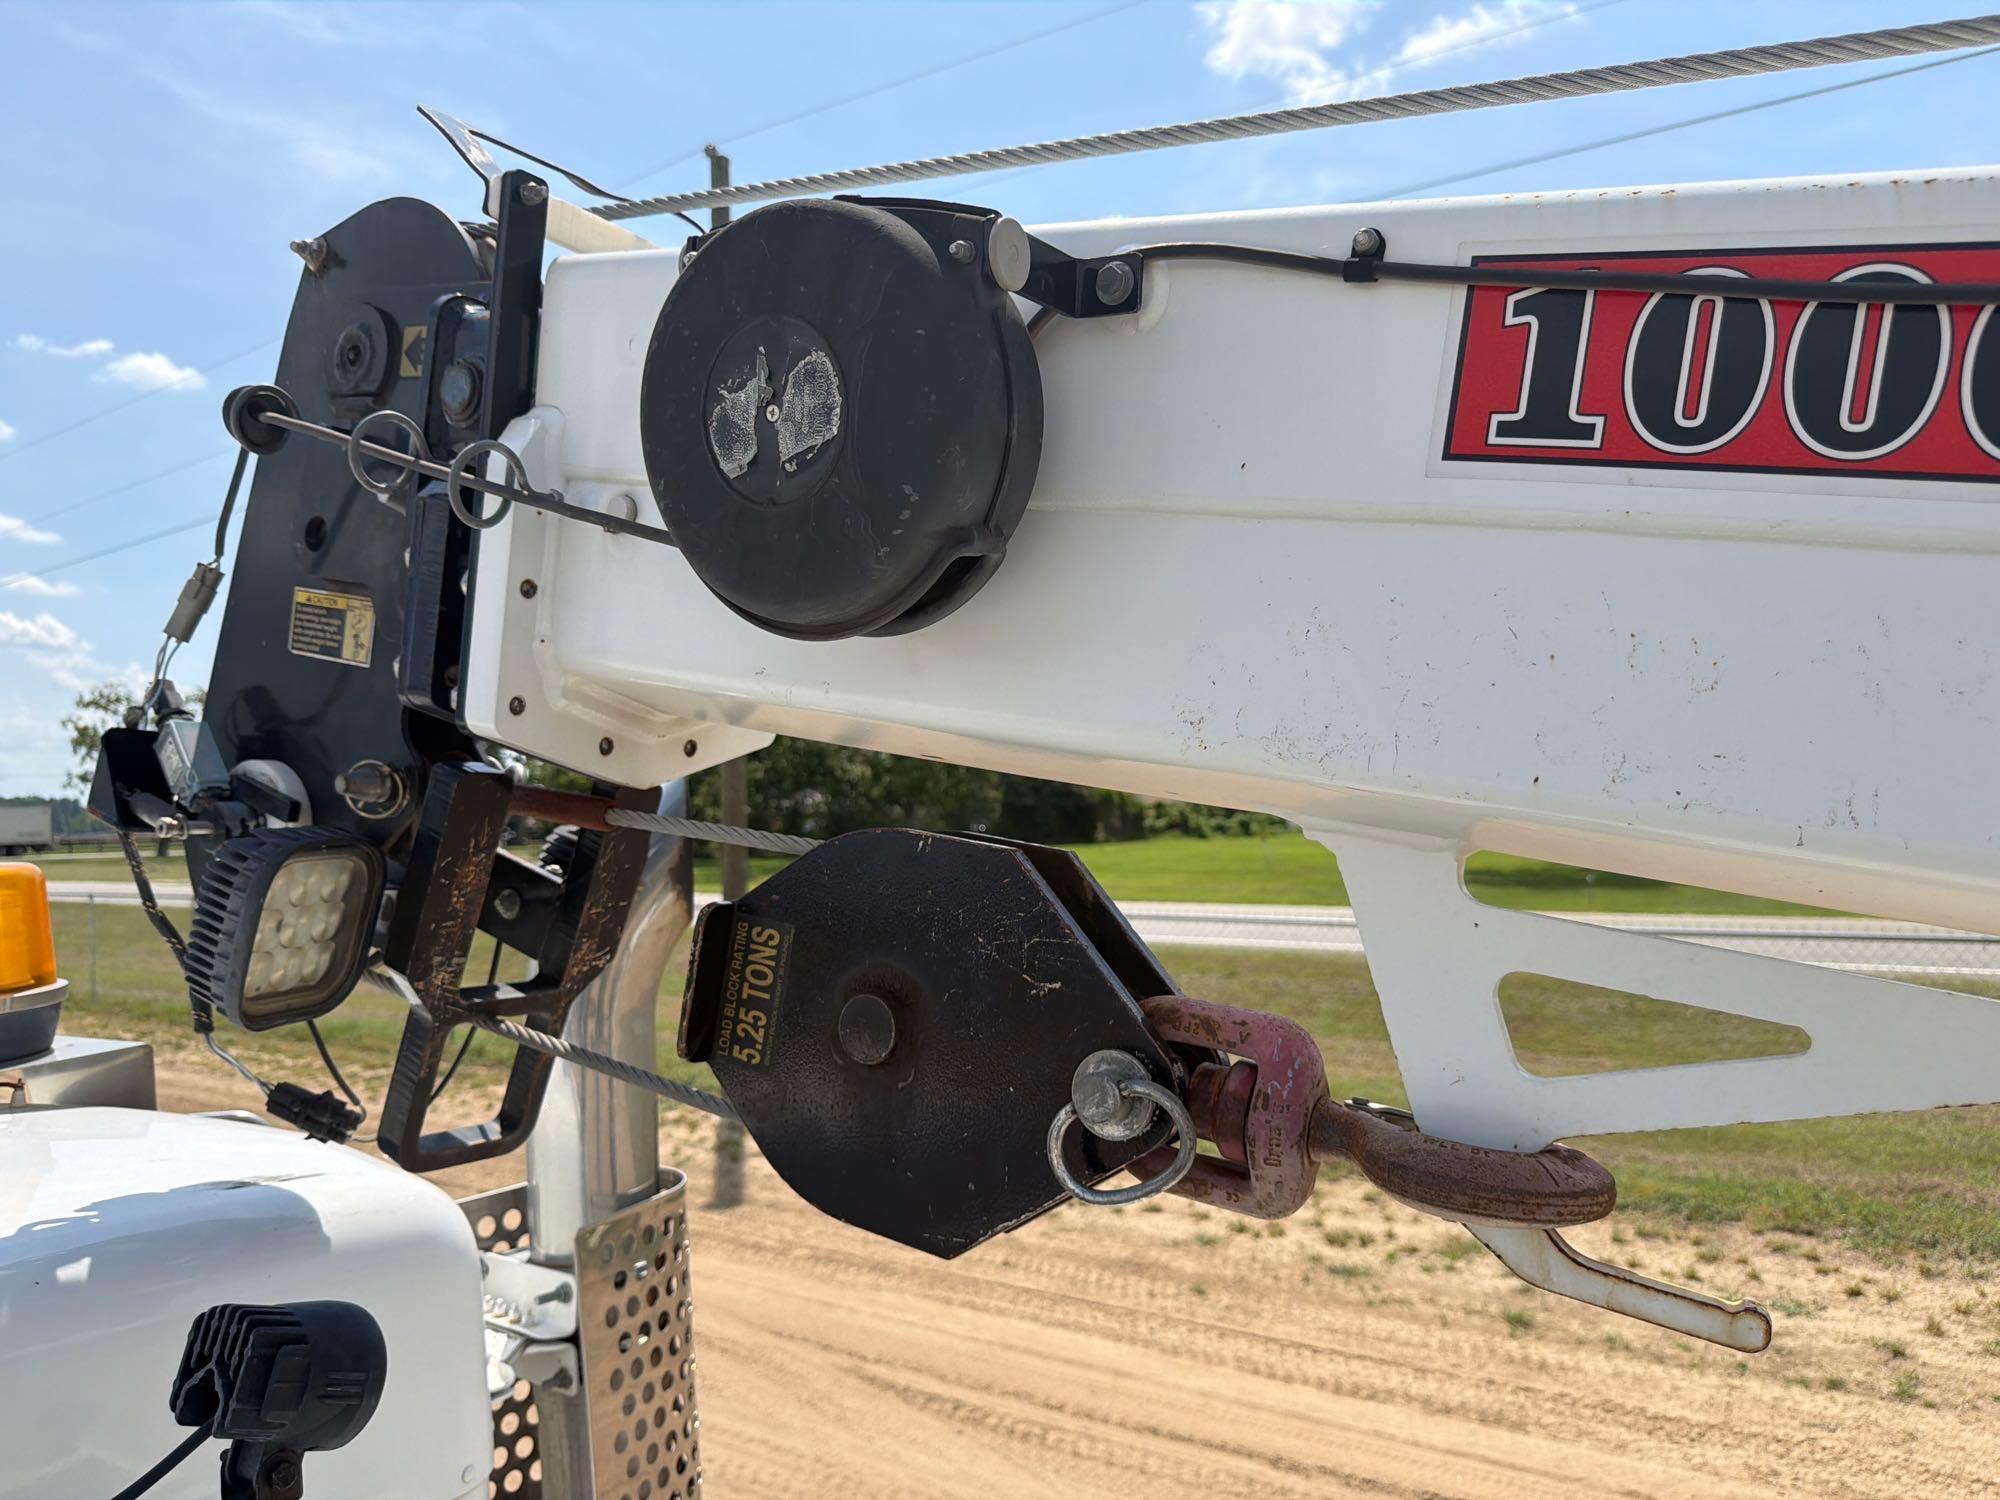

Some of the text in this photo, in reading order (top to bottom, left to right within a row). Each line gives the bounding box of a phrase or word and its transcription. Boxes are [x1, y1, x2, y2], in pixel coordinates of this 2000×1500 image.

[1486, 261, 2000, 464] 100
[719, 921, 749, 1056] LOAD BLOCK RATING
[732, 926, 780, 1065] 5.25 TONS
